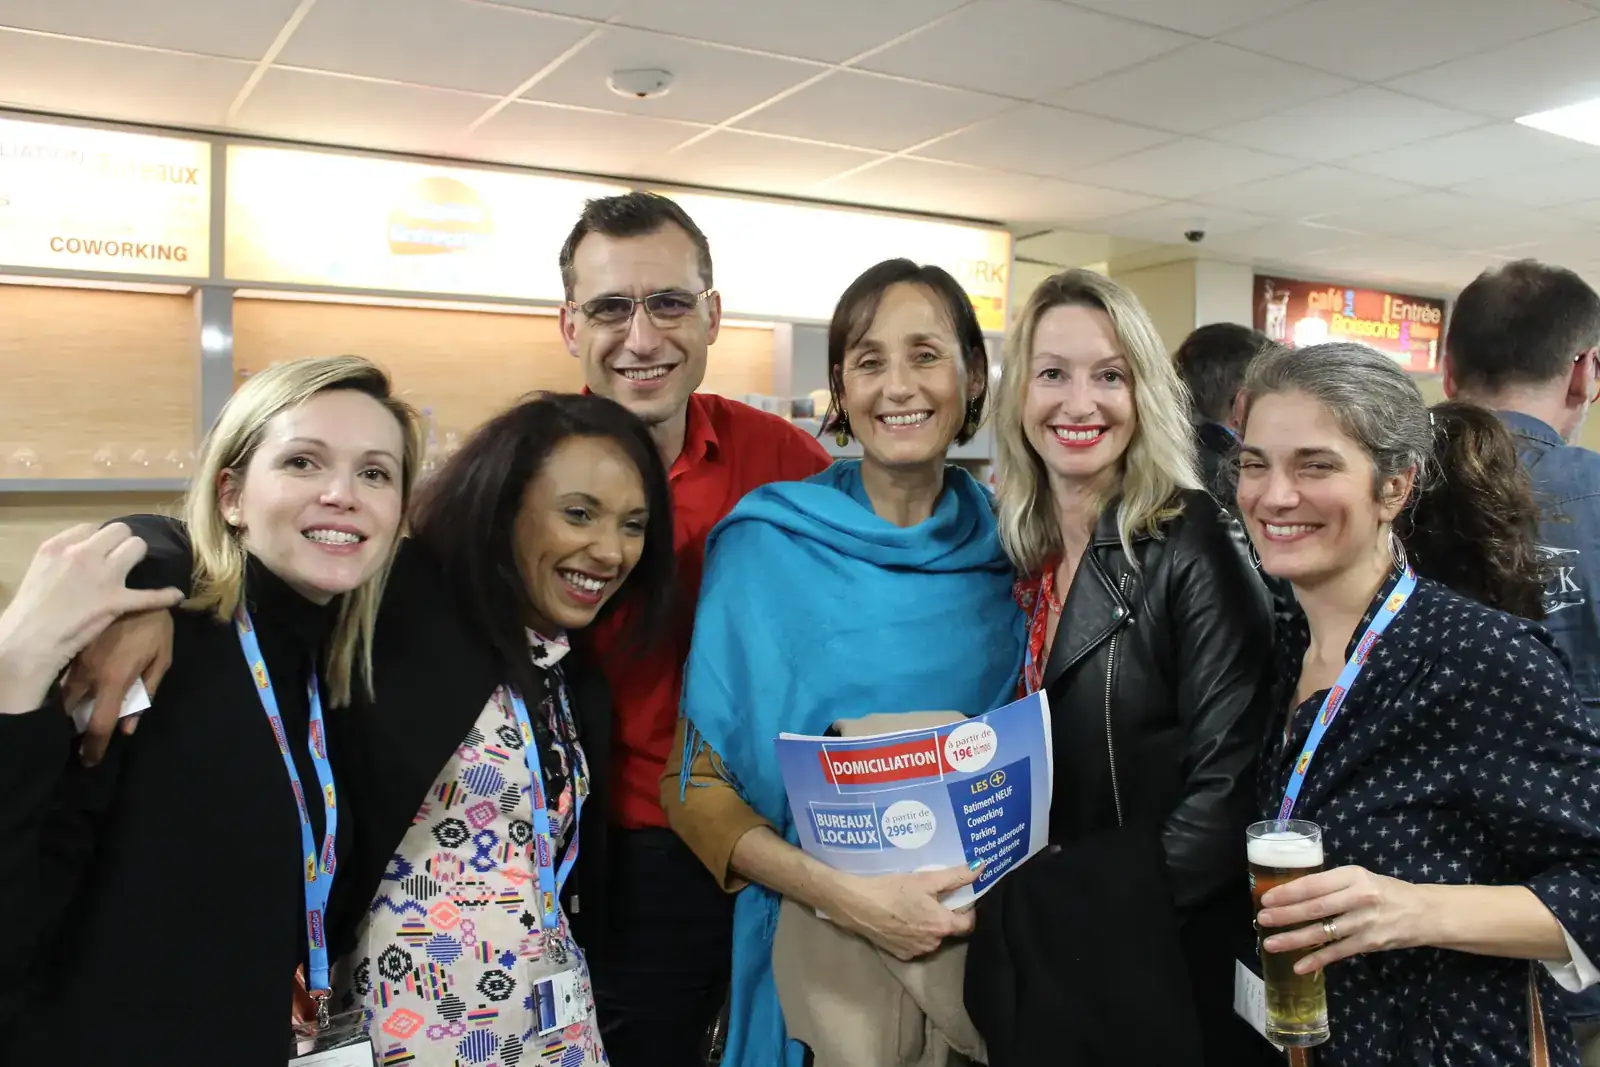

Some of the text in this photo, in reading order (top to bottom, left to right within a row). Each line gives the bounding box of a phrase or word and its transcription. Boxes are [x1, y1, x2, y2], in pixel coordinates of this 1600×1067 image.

[50, 236, 188, 262] COWORKING
[1331, 313, 1400, 339] Boissons
[955, 734, 979, 748] partir
[981, 729, 992, 738] de
[832, 750, 936, 775] DOMICILIATION
[953, 746, 973, 761] 19€
[970, 780, 989, 795] LES
[963, 785, 1013, 815] Batiment NEUF
[816, 813, 874, 828] BUREAUX
[892, 811, 916, 824] partir
[918, 809, 929, 817] de
[967, 807, 1004, 828] Coworking
[820, 829, 878, 844] LOCAUX
[886, 822, 913, 837] 299€
[970, 825, 997, 843] Parking
[974, 822, 1025, 857] Proche autoroute
[984, 838, 1020, 868] pace détente
[979, 856, 1012, 882] Coin cuisine
[312, 911, 321, 947] aggimmo
